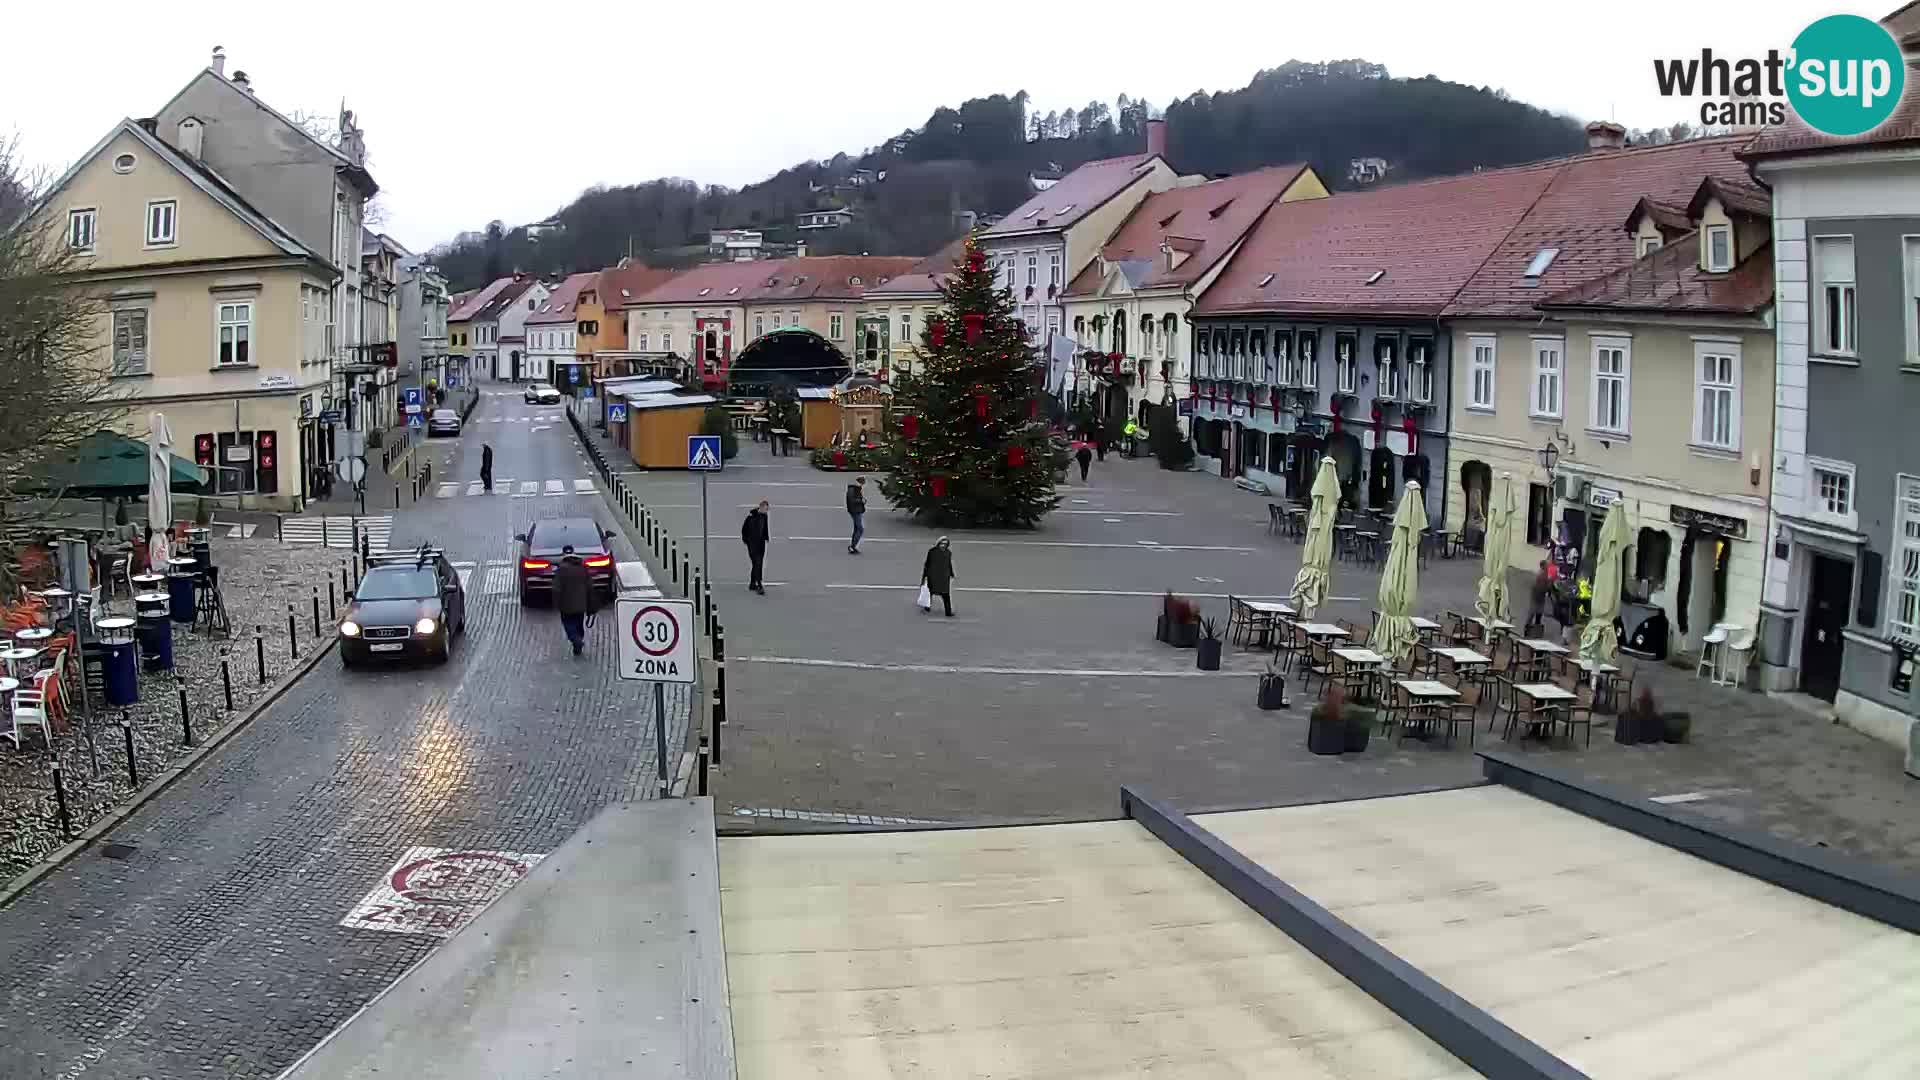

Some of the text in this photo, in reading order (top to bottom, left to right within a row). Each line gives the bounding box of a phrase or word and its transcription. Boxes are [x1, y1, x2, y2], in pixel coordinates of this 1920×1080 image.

[409, 391, 417, 403] P
[644, 621, 668, 643] 30
[635, 659, 679, 676] ZONA
